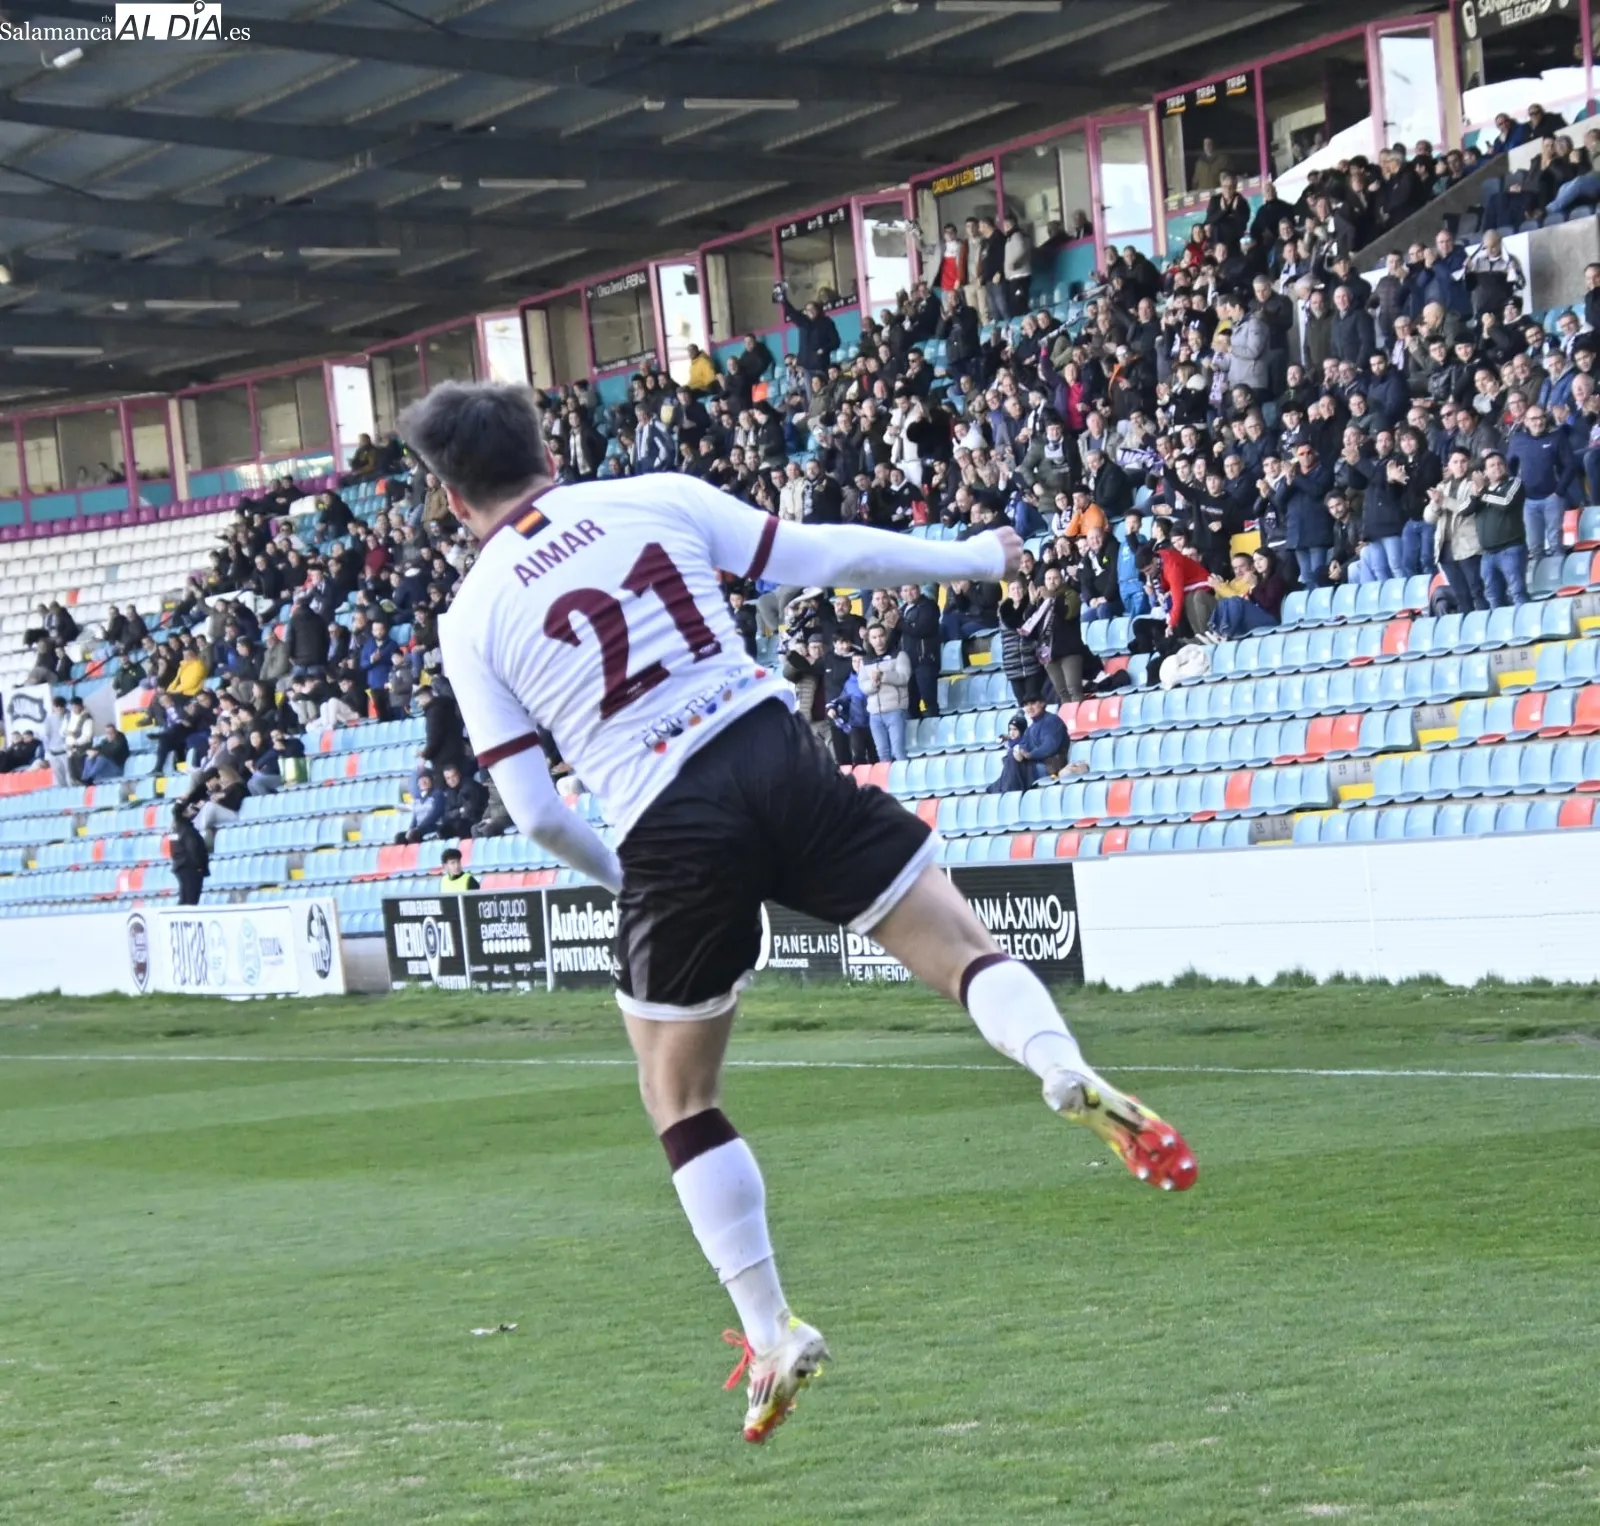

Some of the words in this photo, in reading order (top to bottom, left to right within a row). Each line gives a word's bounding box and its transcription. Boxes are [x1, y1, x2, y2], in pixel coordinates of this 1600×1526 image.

[513, 518, 605, 587] AIMAR
[543, 542, 723, 720] 21
[500, 899, 527, 922] grupo
[481, 921, 529, 939] EMPRESARIAL
[774, 933, 840, 959] PANELAIS
